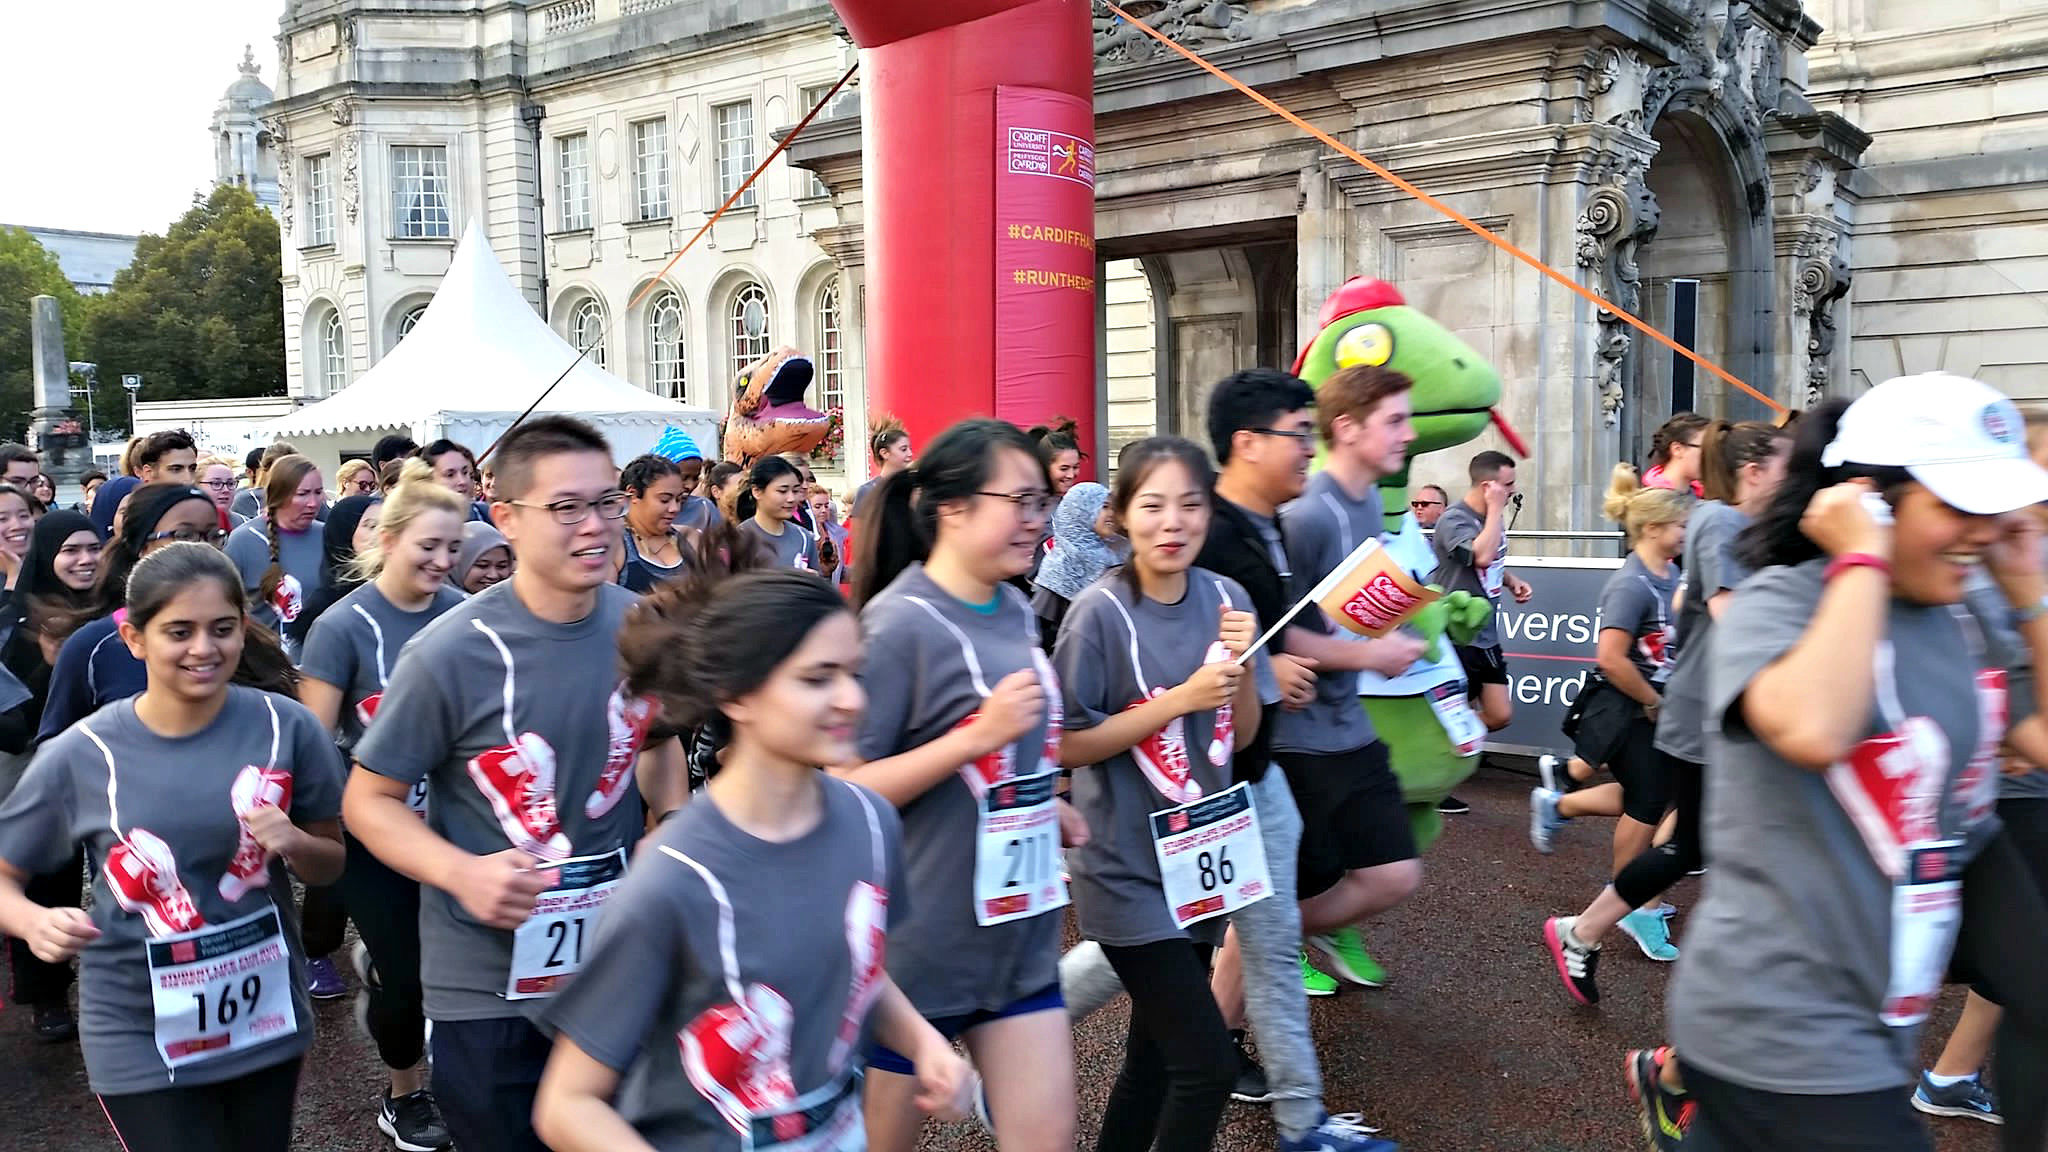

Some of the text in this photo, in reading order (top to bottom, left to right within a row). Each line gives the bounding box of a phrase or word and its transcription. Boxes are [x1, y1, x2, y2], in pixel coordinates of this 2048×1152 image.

[1012, 131, 1048, 144] CARDIFF
[1013, 142, 1047, 150] UNIVERSITY
[1198, 845, 1234, 891] 86
[544, 918, 585, 968] 21
[192, 974, 262, 1032] 169
